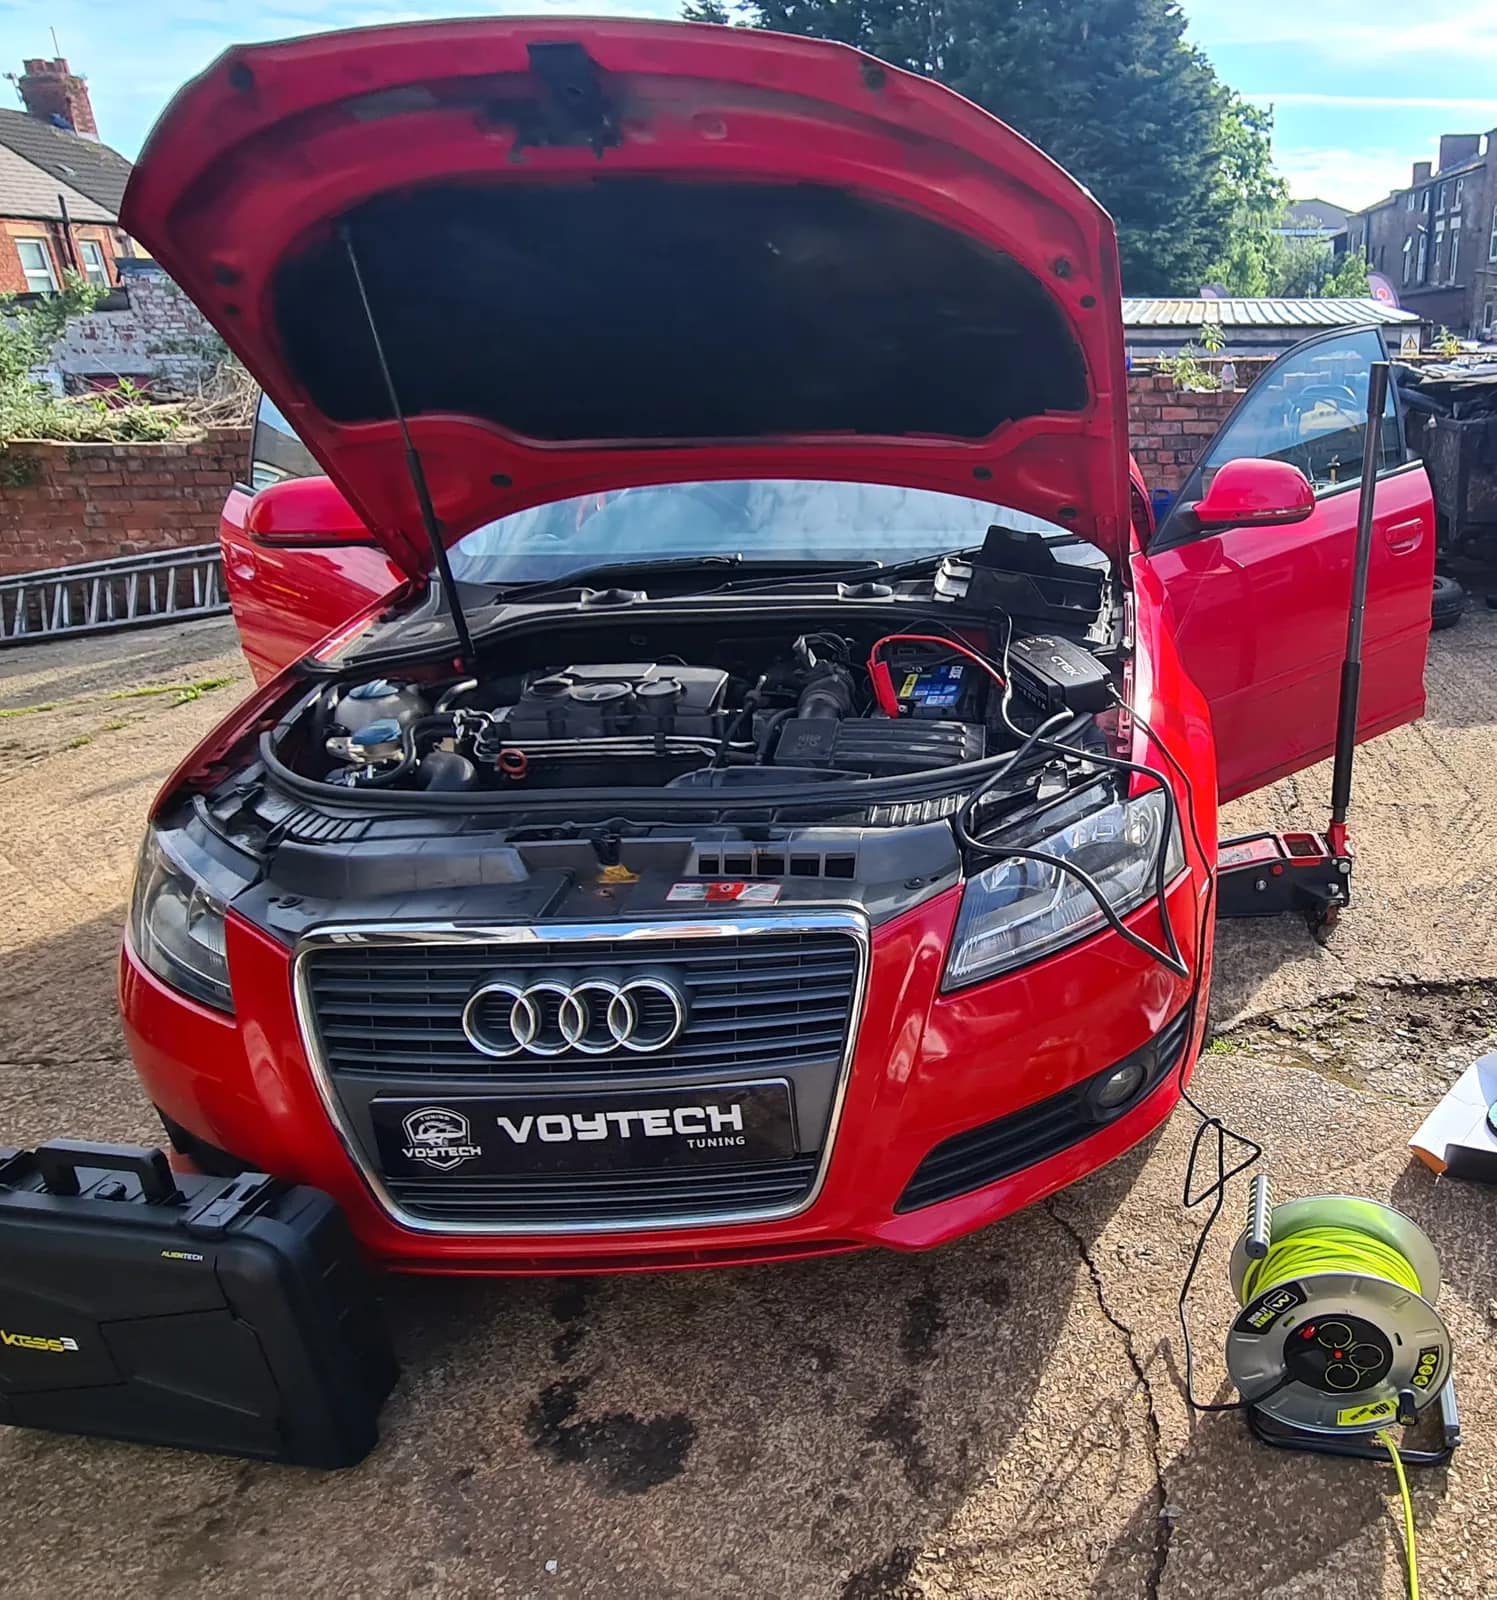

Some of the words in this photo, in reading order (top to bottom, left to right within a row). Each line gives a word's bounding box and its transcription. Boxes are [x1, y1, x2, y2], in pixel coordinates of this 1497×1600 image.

[1050, 655, 1080, 677] CTEK
[497, 1104, 743, 1143] VOYTECH
[687, 1136, 746, 1149] TUNING
[401, 1146, 482, 1158] VOYTECH
